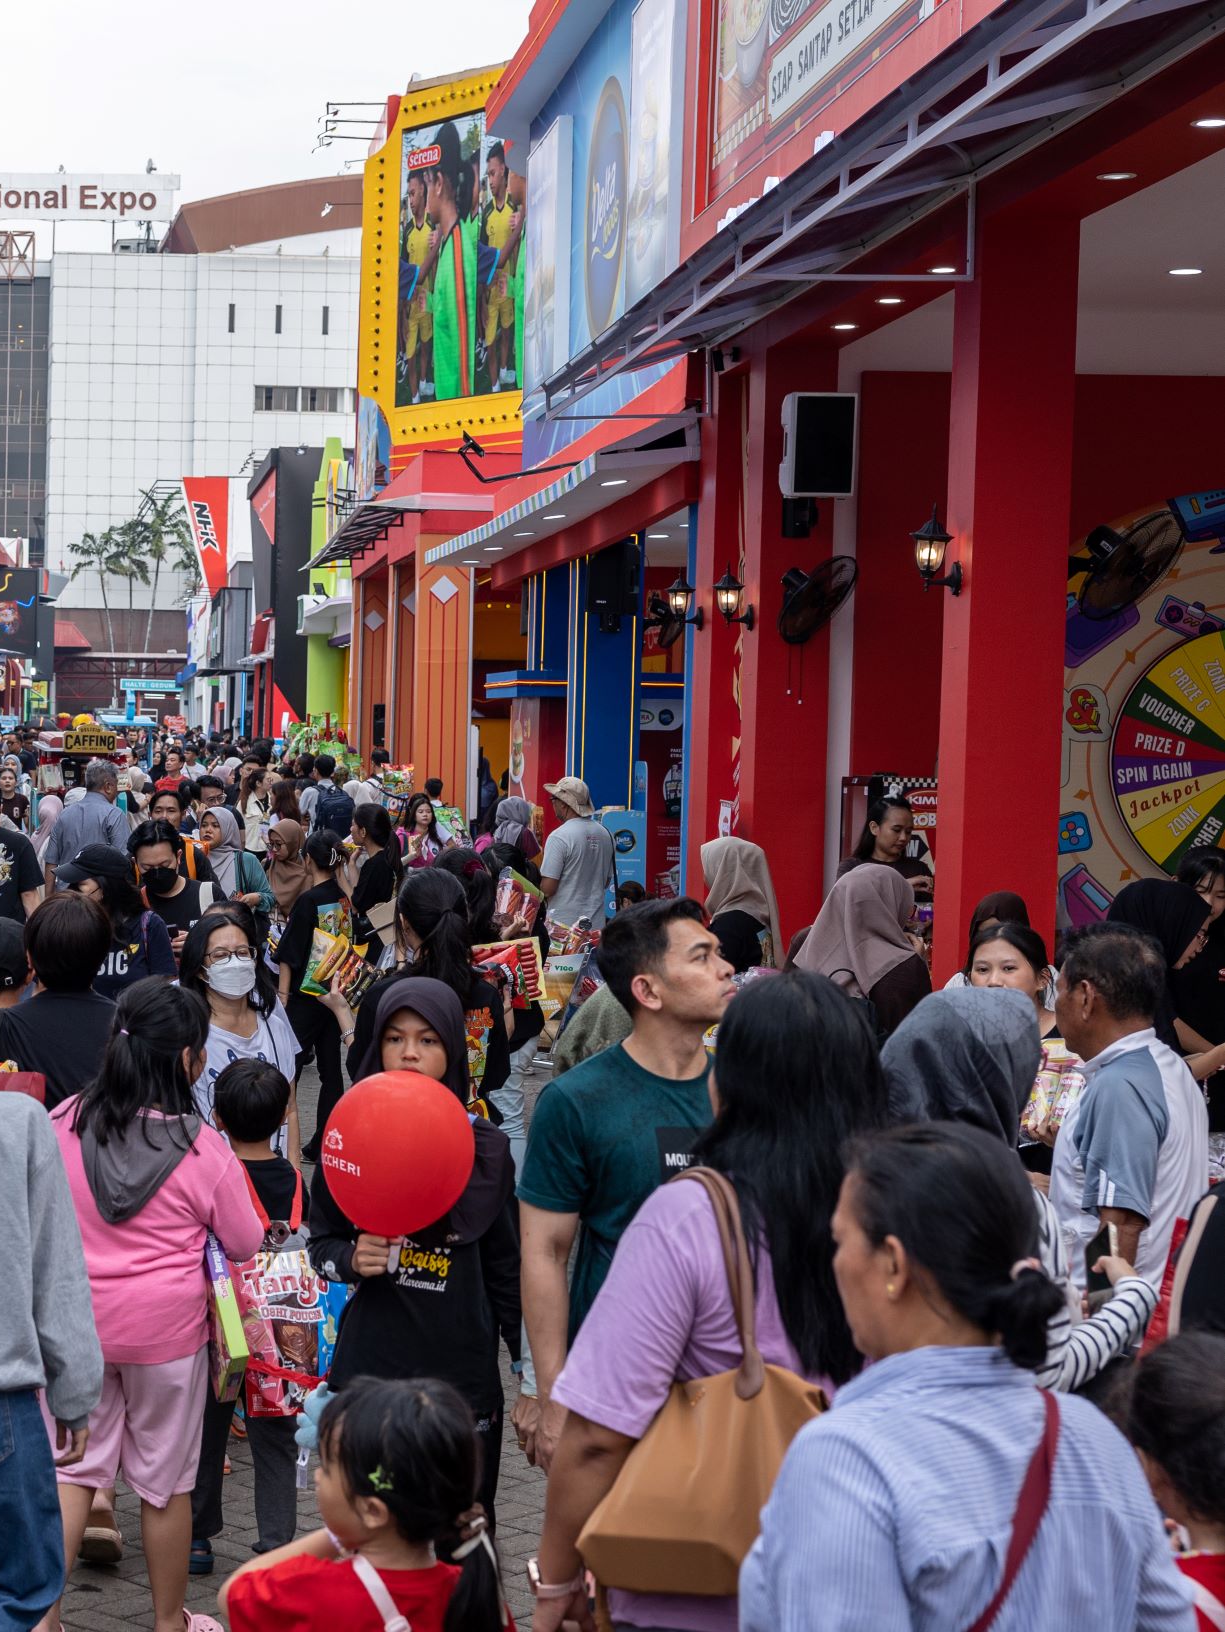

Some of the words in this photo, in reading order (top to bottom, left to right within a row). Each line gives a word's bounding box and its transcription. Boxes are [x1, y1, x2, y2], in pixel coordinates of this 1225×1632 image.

[771, 60, 793, 105] SIAP
[797, 22, 832, 80] SANTAP
[408, 148, 439, 167] serena
[79, 185, 157, 215] Expo
[1169, 666, 1200, 701] PRIZE
[1195, 698, 1211, 713] C
[1138, 692, 1196, 735] VOUCHER
[64, 734, 116, 751] CAFFINO
[1134, 732, 1172, 755] PRIZE
[1176, 741, 1186, 757] D
[1117, 765, 1148, 784] SPIN
[1152, 761, 1193, 780] AGAIN
[1129, 779, 1201, 819] Jackpot
[1167, 803, 1201, 837] ZONK
[1188, 816, 1224, 850] CHER
[665, 1152, 694, 1167] MOU
[213, 1250, 224, 1273] Berapa
[400, 1248, 451, 1277] Daisy
[242, 1270, 329, 1307] Tango
